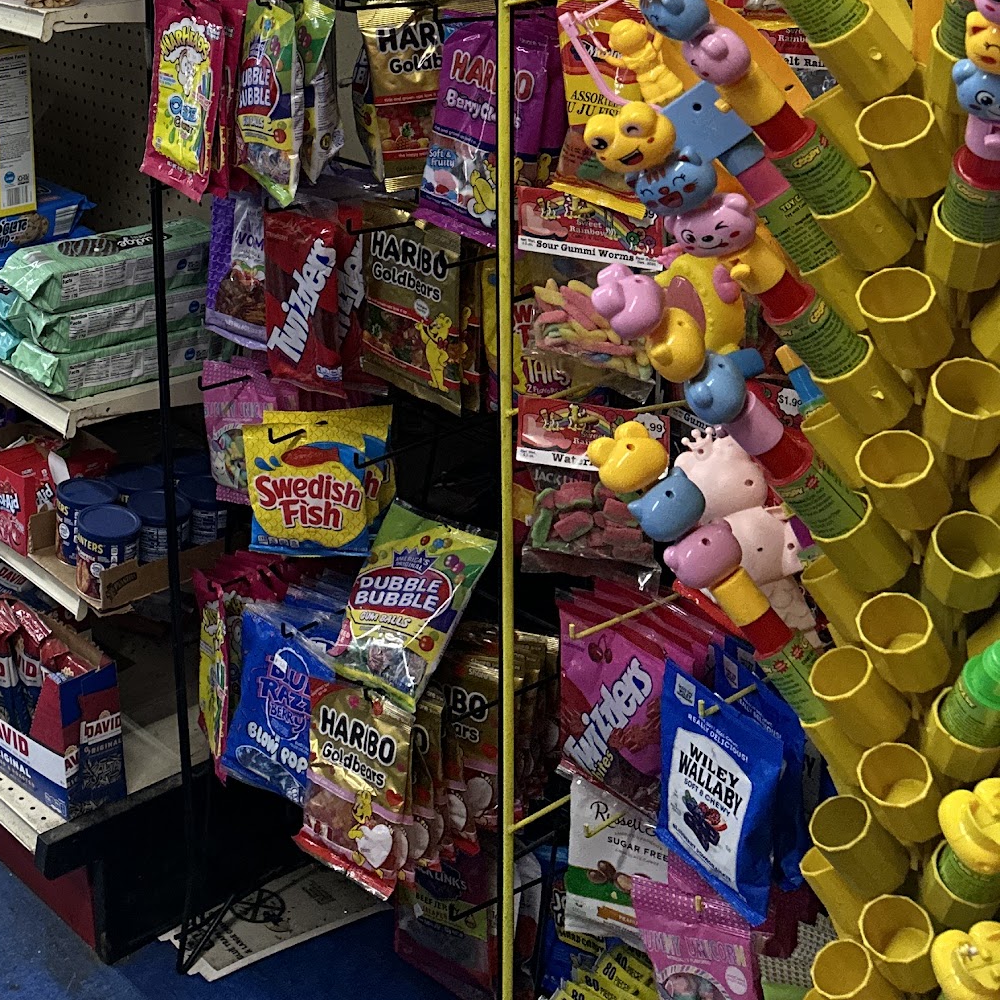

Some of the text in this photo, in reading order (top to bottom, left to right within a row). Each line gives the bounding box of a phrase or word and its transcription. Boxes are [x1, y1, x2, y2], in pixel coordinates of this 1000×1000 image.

[577, 220, 602, 228] Sweet
[370, 231, 448, 281] HARIBO
[536, 240, 634, 262] Sour Gummi Worms
[372, 262, 442, 302] Goldbears
[254, 474, 362, 511] Swedish
[279, 500, 343, 529] Fish
[359, 575, 442, 595] DUBBLE
[354, 589, 439, 612] BUBBLE
[359, 611, 411, 628] GUM BALLS
[87, 717, 121, 738] DAVID
[269, 702, 306, 732] BERRY
[248, 721, 278, 751] BLOW
[320, 705, 397, 768] HARIBO
[688, 713, 748, 763] REALLY DELICIOUS!
[322, 742, 385, 788] Goldbears
[690, 742, 739, 789] WILEY
[679, 750, 743, 820] WALLABY
[684, 778, 730, 817] SOFT CHEWY
[607, 836, 669, 863] SUGAR FREE
[585, 975, 599, 991] 80
[603, 963, 615, 981] 80
